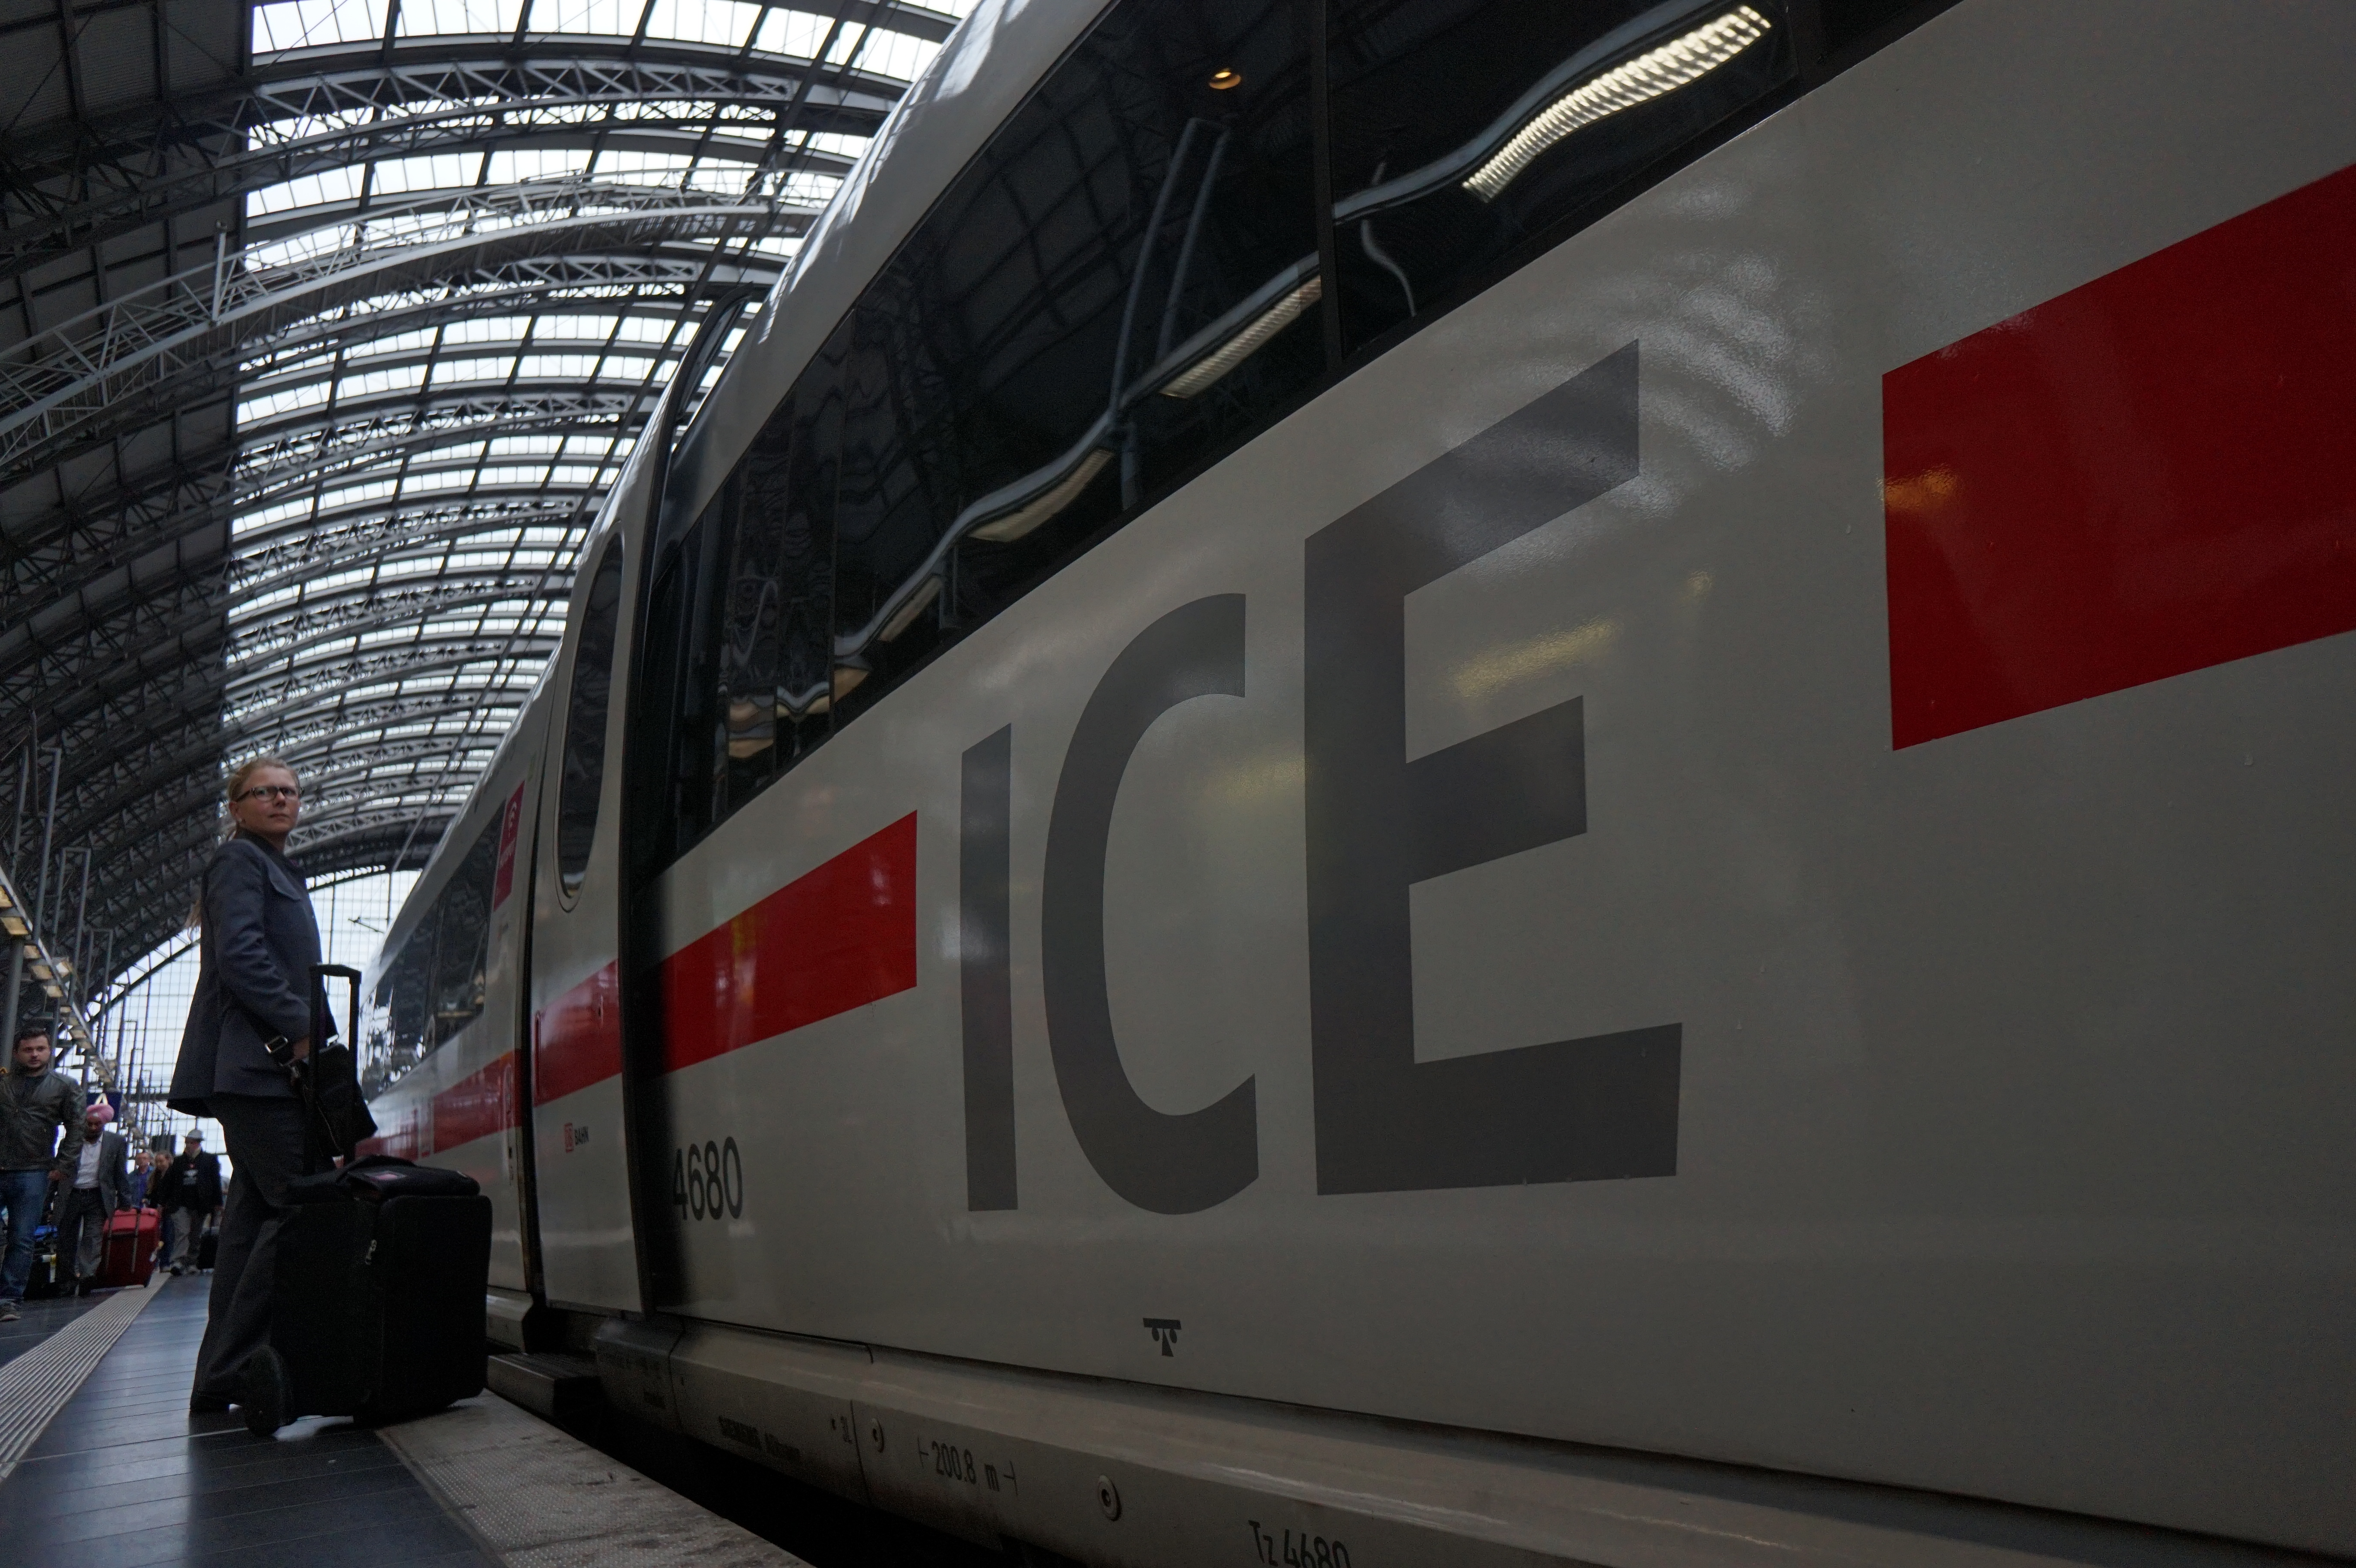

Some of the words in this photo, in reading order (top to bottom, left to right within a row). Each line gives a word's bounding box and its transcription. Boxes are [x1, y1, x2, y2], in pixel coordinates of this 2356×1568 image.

[960, 338, 1682, 1214] ICE
[674, 1136, 743, 1220] 4680
[931, 1441, 977, 1484] 200.8
[985, 1463, 1000, 1492] m
